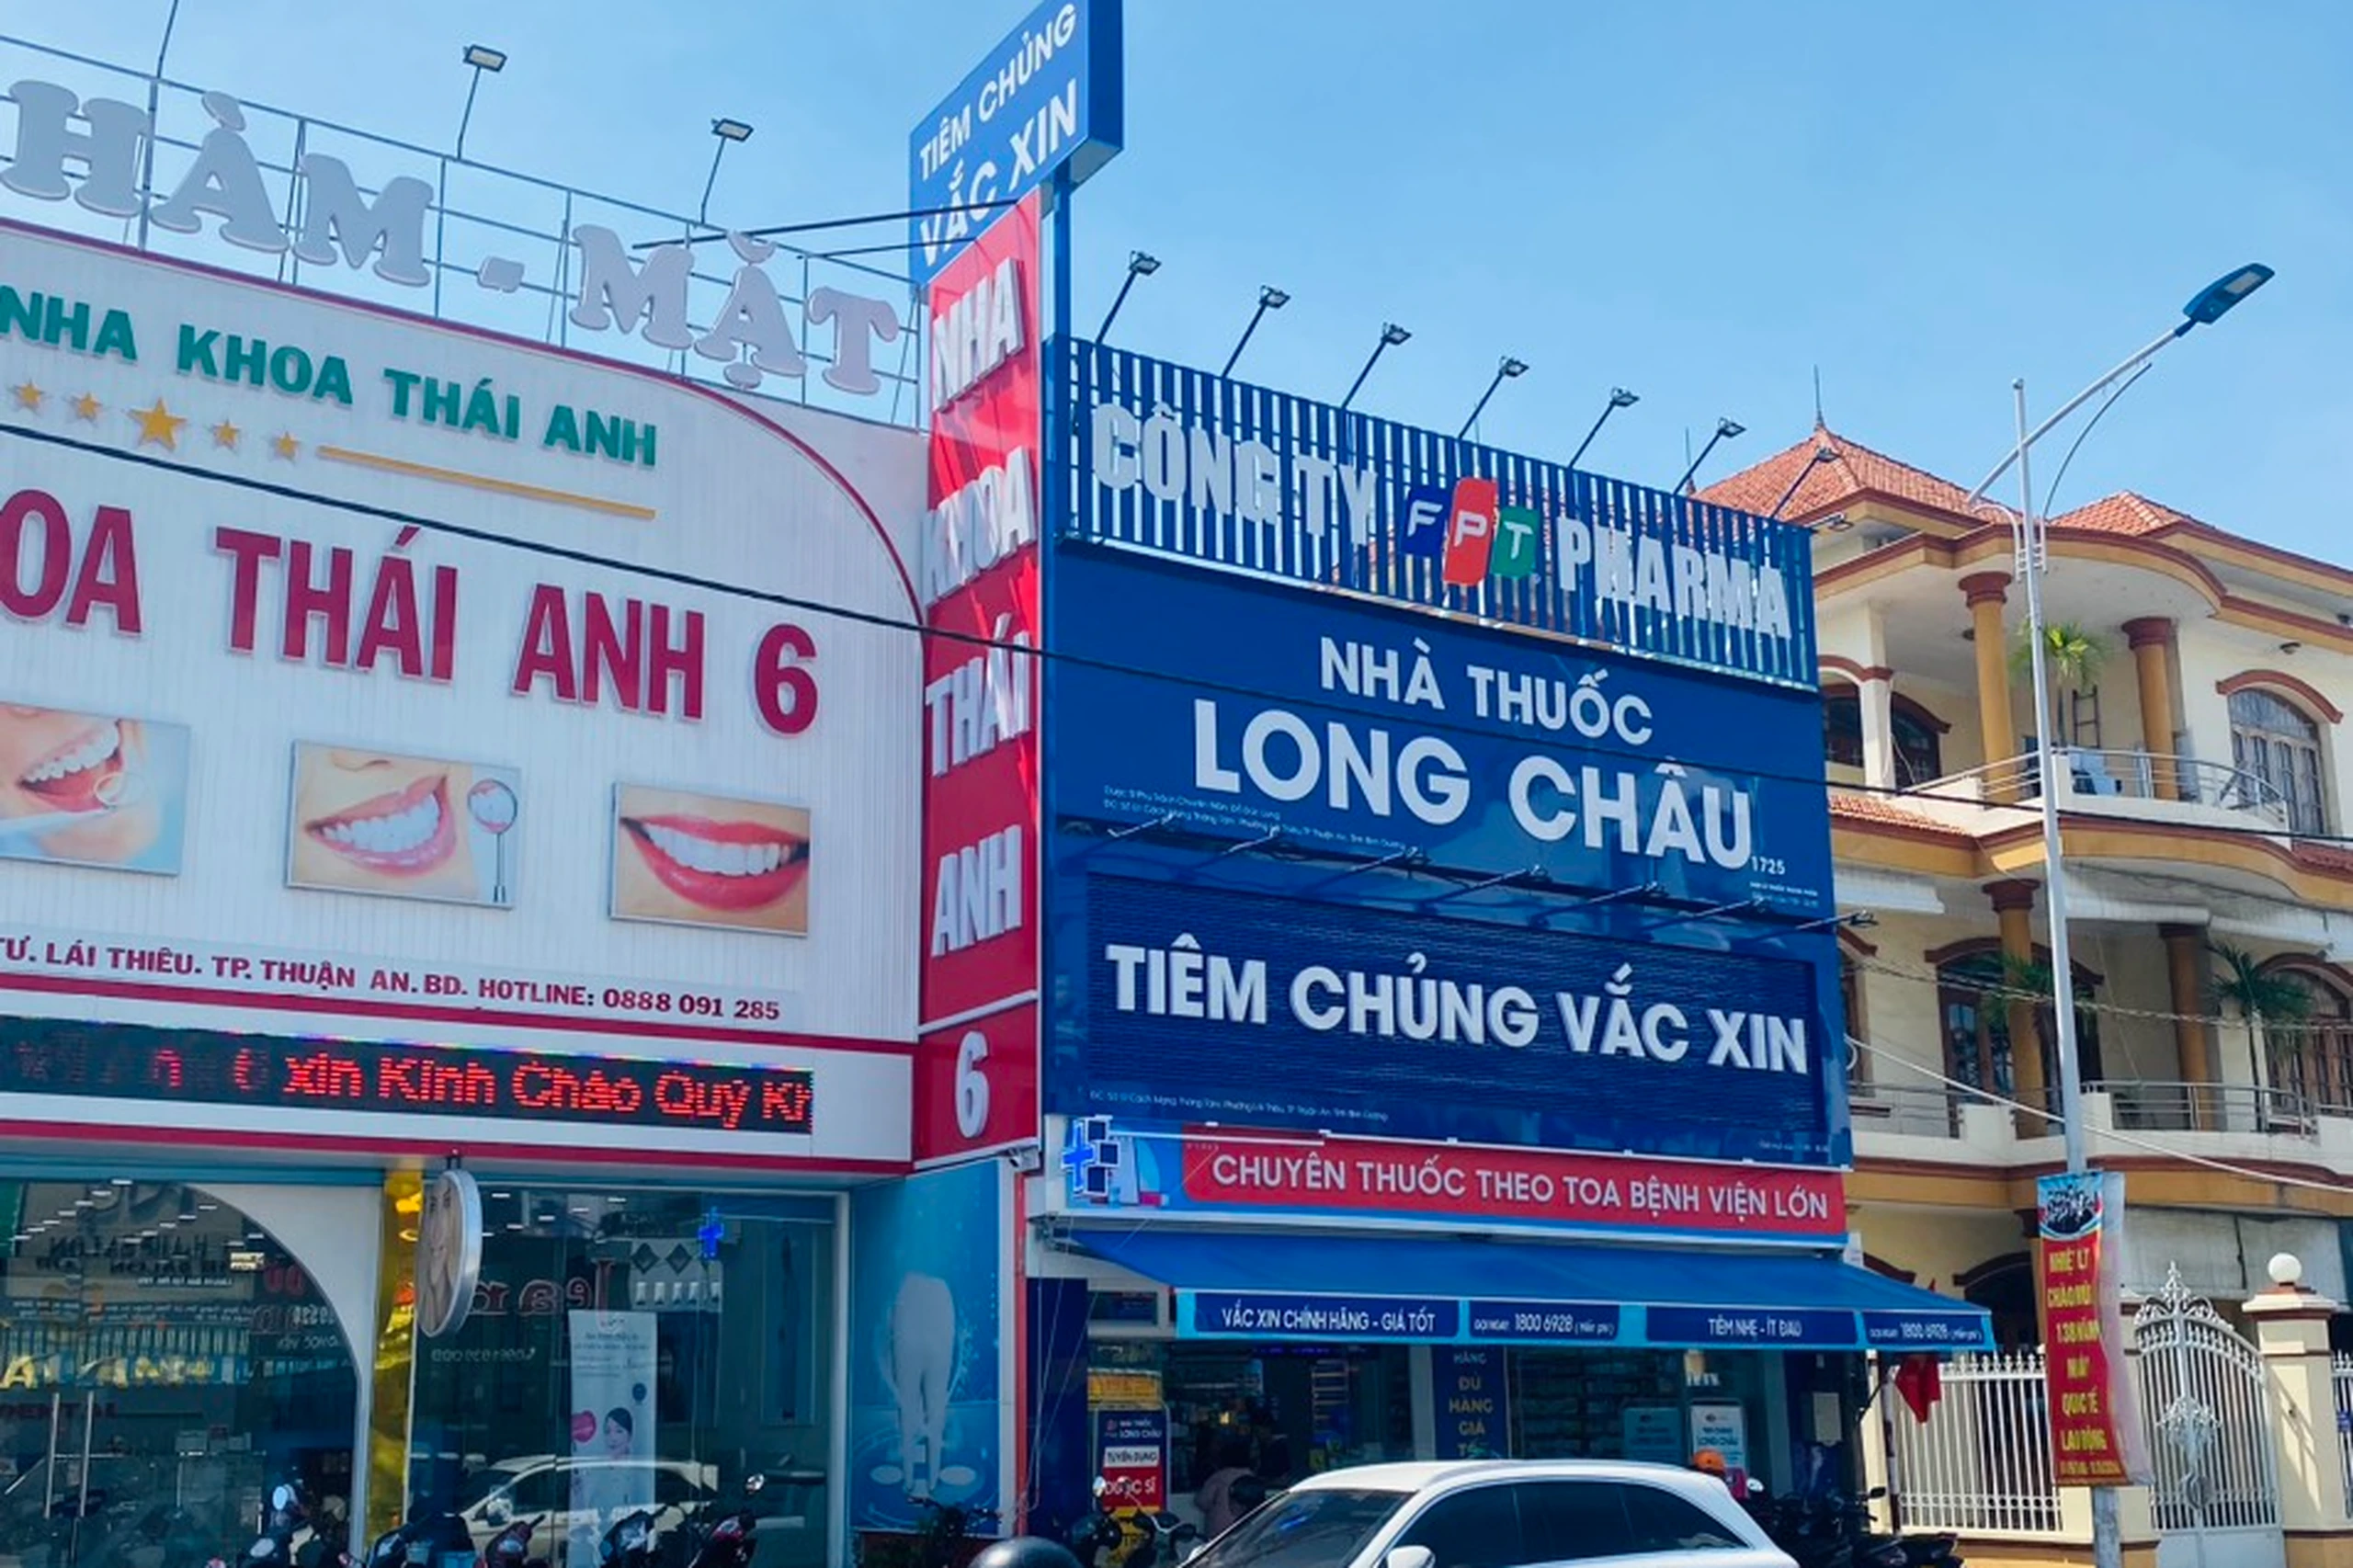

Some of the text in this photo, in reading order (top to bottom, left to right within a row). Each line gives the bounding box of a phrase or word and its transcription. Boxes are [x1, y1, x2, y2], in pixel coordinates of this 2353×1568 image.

[920, 3, 1076, 182] TIÊM CHỦNG
[0, 80, 434, 286] HÀM
[568, 223, 899, 395] MẶT
[920, 79, 1077, 267] VẮC XIN
[0, 285, 657, 466] NHA KHOA THÁI ANH
[932, 257, 1026, 415] NHA
[923, 448, 1036, 608] KHOA
[1091, 401, 1792, 641] CÔNG TY FPT PHARMA
[0, 489, 819, 737] OA THÁI ANH 6
[925, 613, 1030, 778] THÁI
[1320, 636, 1654, 746] NHÀ THUỐC
[1194, 698, 1754, 869] LONG CHÂU
[930, 824, 1023, 958] ANH
[1751, 855, 1786, 875] 1725
[0, 936, 36, 961] Ư.
[46, 939, 96, 967] LÁI
[107, 947, 202, 974] THIÊU.
[211, 956, 252, 979] TP.
[260, 960, 355, 990] THUẬN
[479, 978, 594, 1006] HOTLINE:
[603, 988, 671, 1012] 0888
[678, 994, 724, 1017] 091
[733, 1000, 780, 1020] 285
[1106, 933, 1809, 1075] TIÊM CHỦNG VẮC XIN
[955, 1030, 990, 1138] 6
[1212, 1152, 1828, 1223] CHUYÊN THUỐC THEO TOA BỆNH VIỆN LỚN
[1222, 1299, 1254, 1328] VẮC
[1256, 1309, 1280, 1328] XIN
[1283, 1304, 1327, 1329] CHÍNH
[1328, 1307, 1370, 1330] HÃNG
[1381, 1308, 1405, 1331] GIÁ
[1407, 1306, 1436, 1331] TỐT
[1515, 1313, 1541, 1332] 1800
[1543, 1313, 1574, 1333] 6928
[1708, 1314, 1733, 1335] TIÊM
